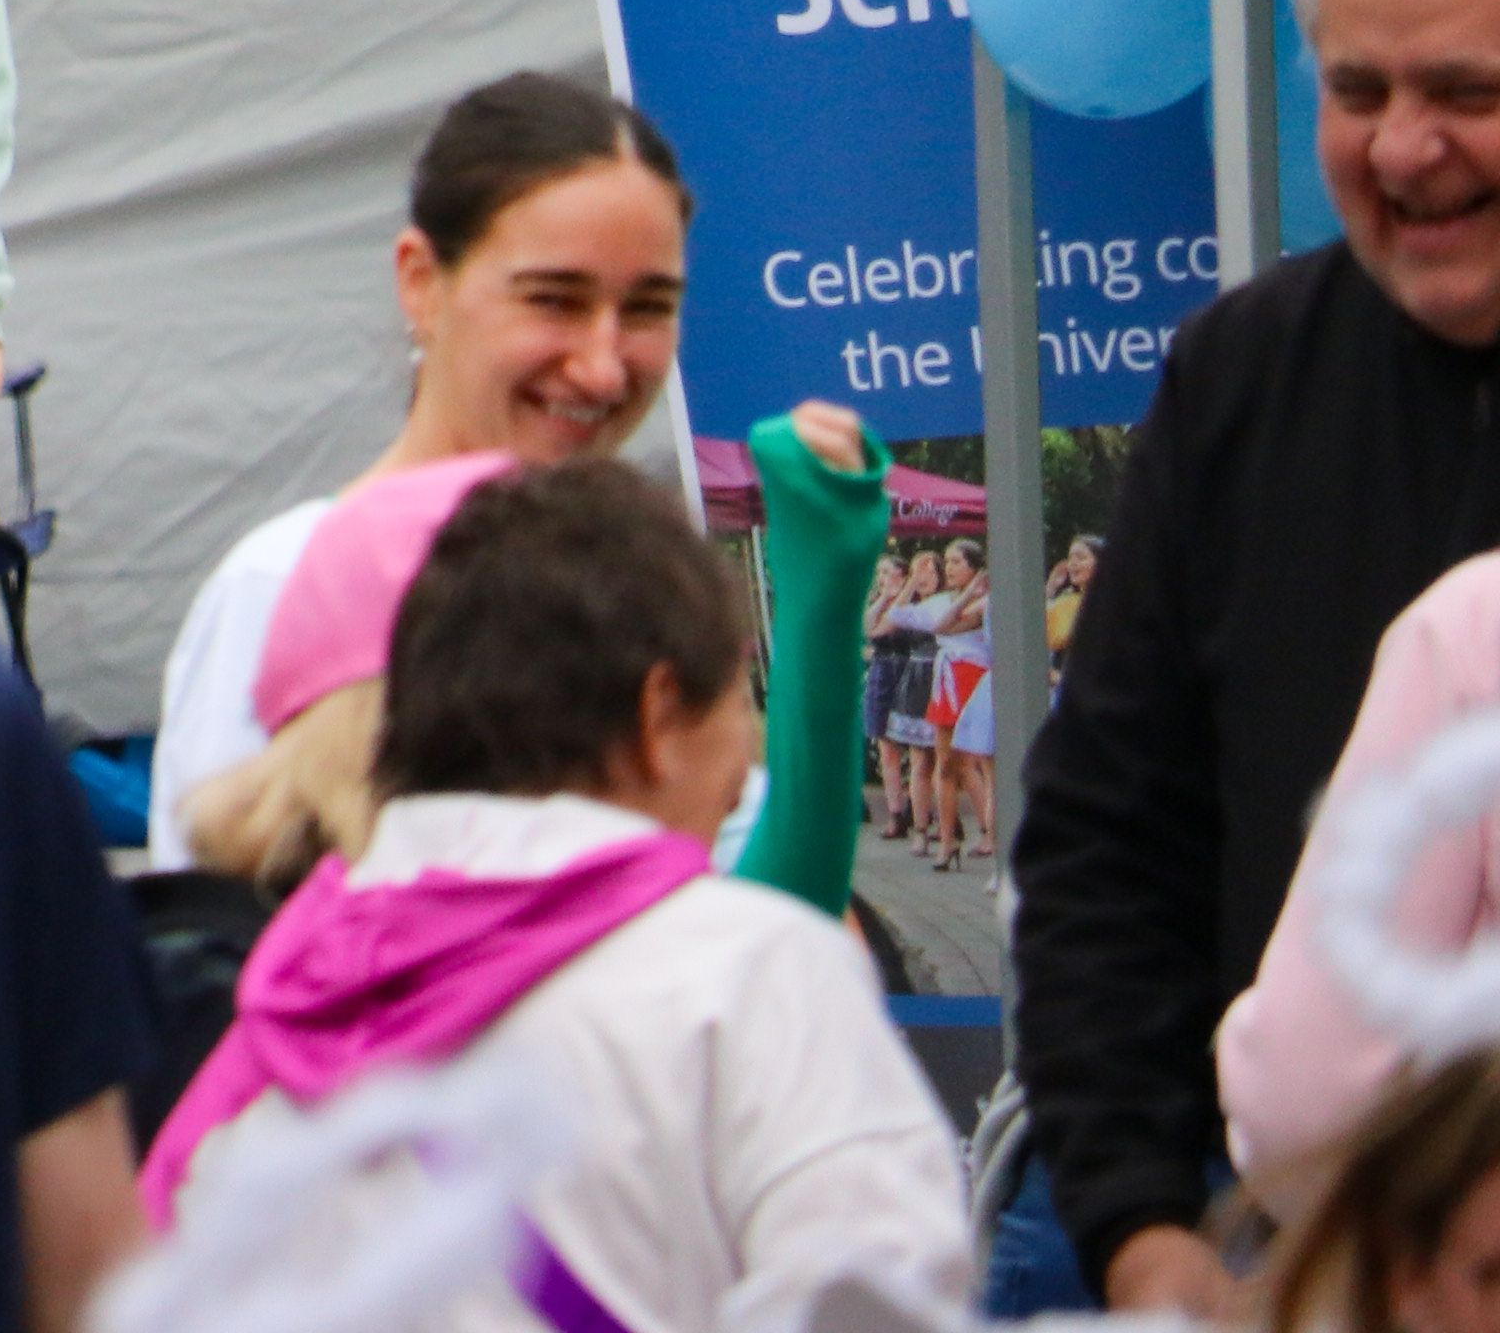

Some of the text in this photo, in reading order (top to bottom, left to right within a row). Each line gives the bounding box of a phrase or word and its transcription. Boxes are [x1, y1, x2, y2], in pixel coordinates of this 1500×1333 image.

[763, 229, 1220, 309] Celebring co
[841, 316, 1178, 391] the niver
